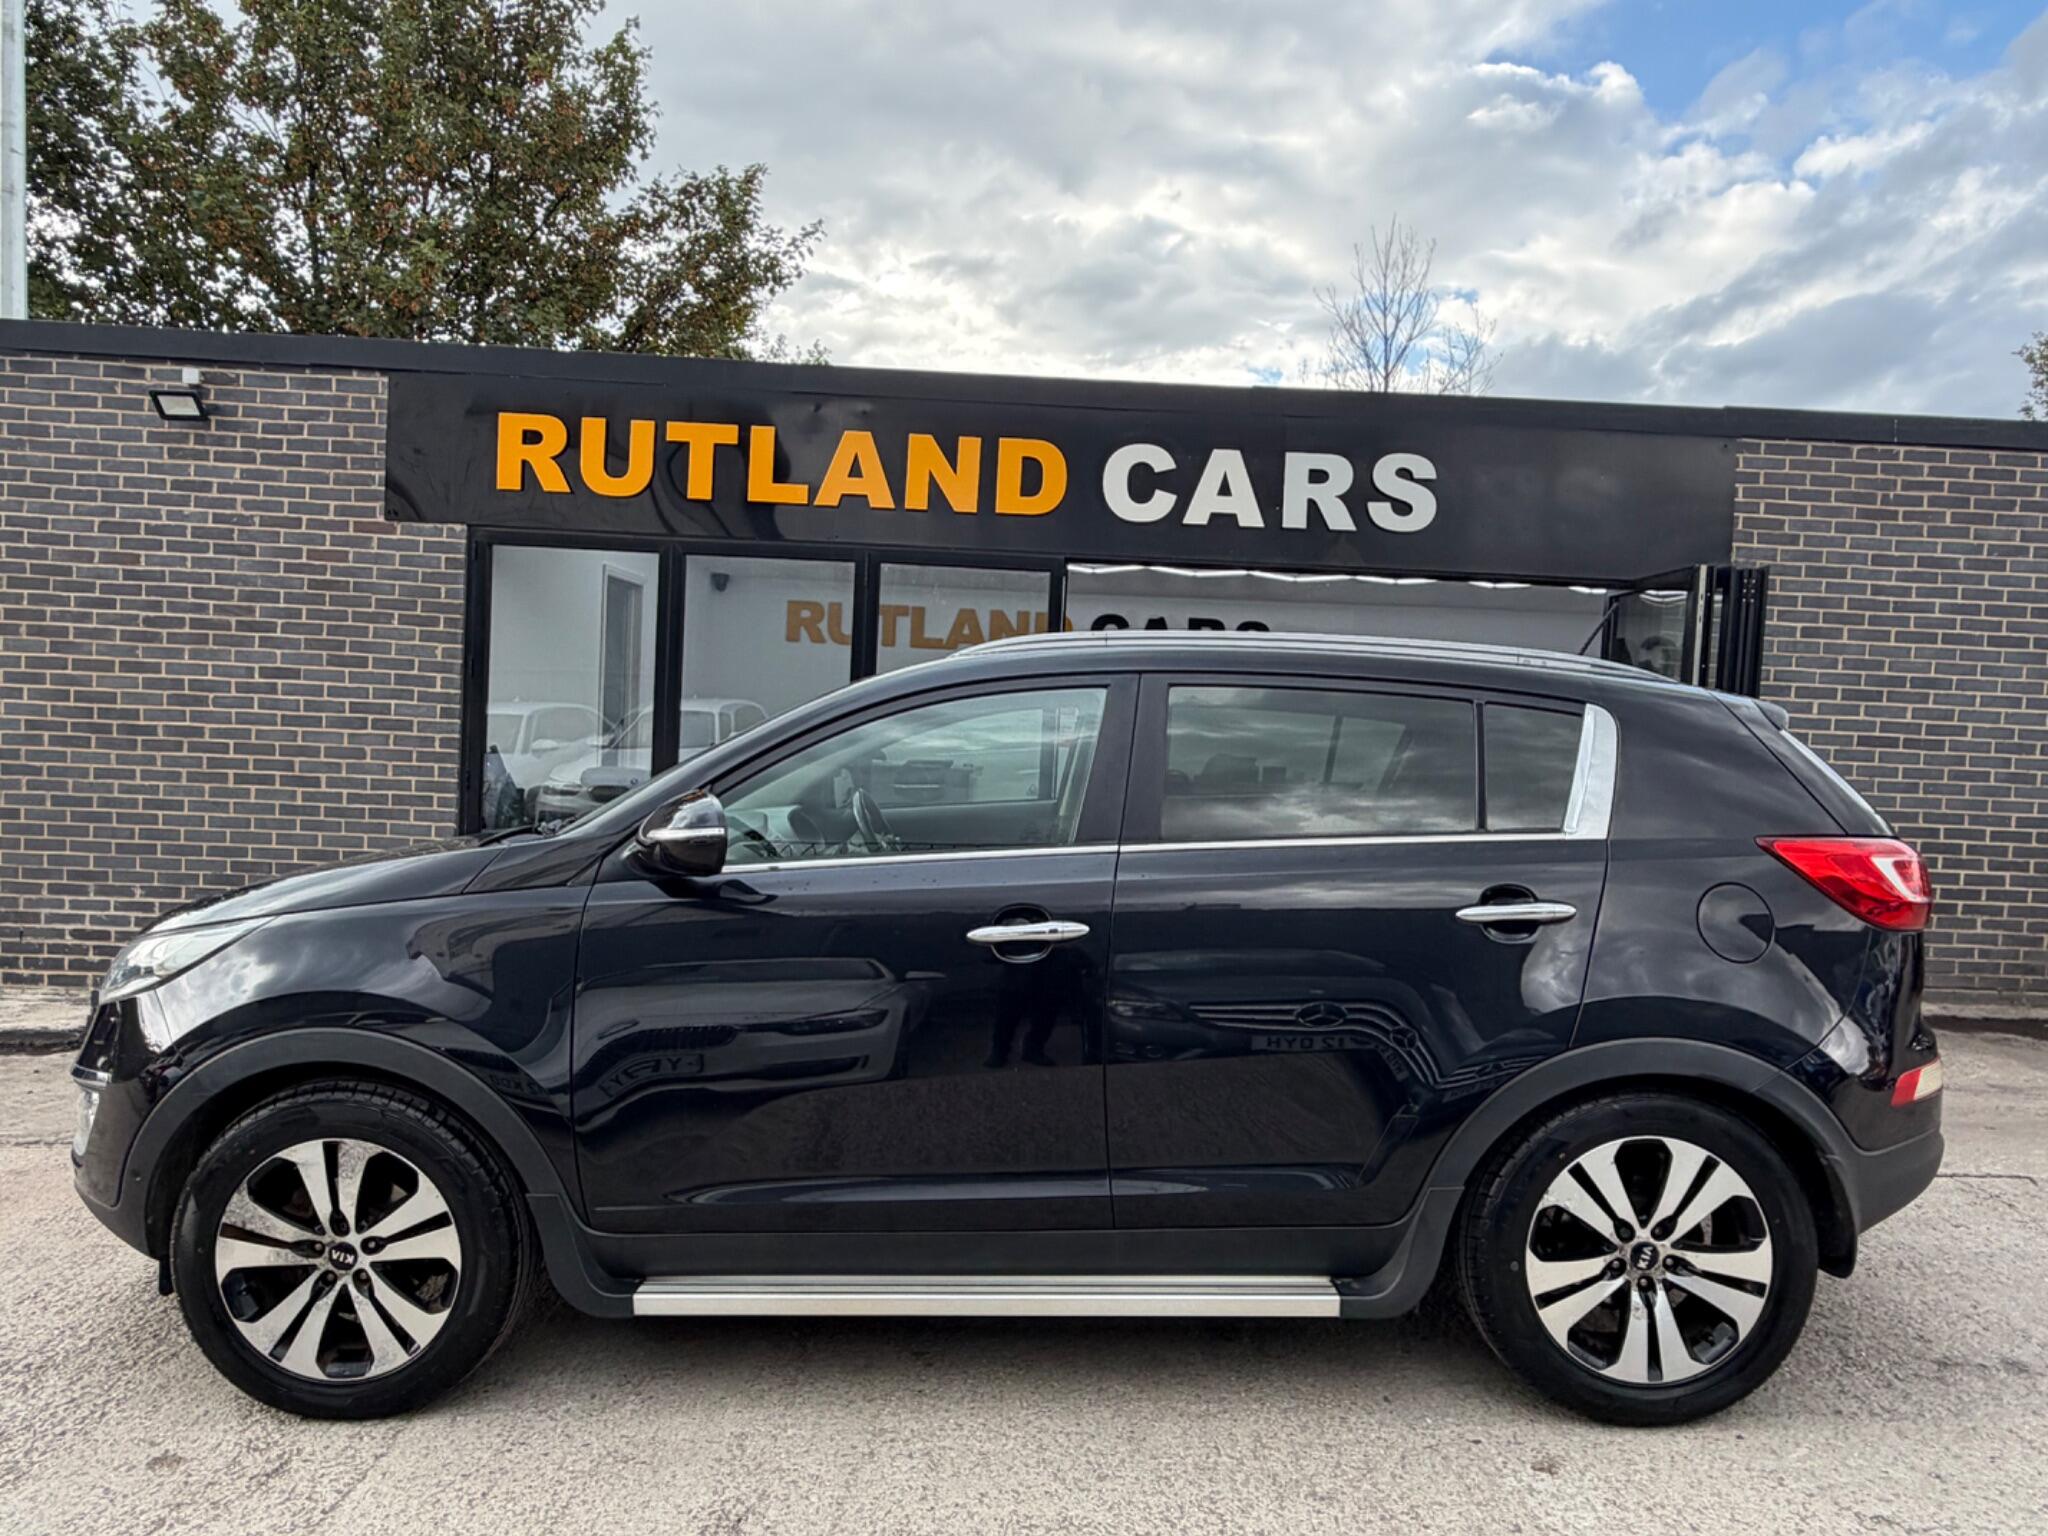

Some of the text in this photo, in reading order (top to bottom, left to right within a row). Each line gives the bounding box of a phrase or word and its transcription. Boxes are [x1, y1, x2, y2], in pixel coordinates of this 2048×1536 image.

[496, 412, 1437, 533] RUTLAND CARS
[331, 1249, 355, 1264] KIA
[1637, 1247, 1653, 1268] KIA
